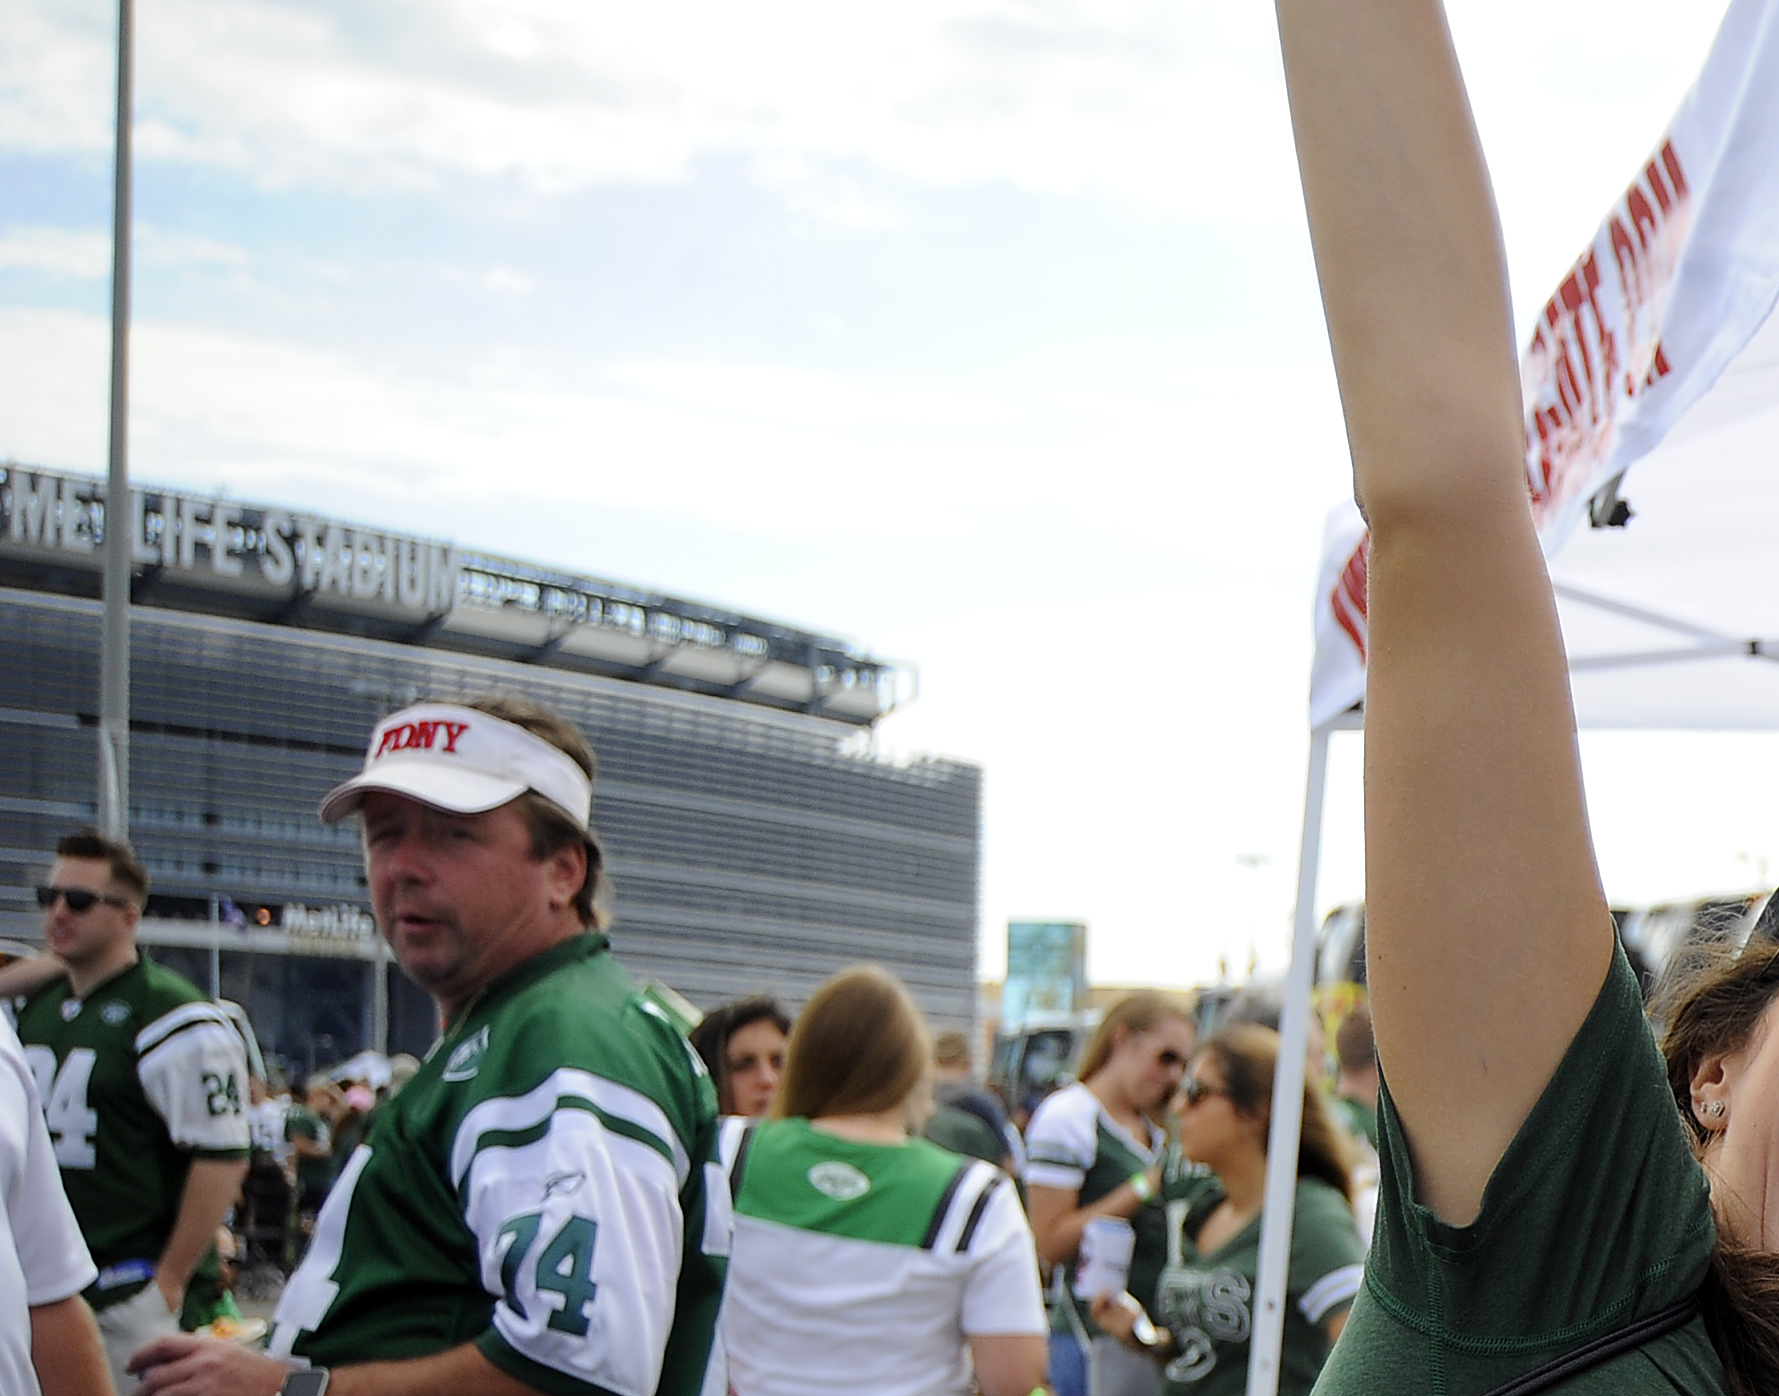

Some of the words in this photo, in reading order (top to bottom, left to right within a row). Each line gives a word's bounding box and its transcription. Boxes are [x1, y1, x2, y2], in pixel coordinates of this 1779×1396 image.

[10, 470, 245, 578] MELIFE
[261, 508, 456, 611] STADIUM
[375, 720, 469, 759] FDNY
[202, 1073, 240, 1115] 24
[499, 1212, 598, 1337] 74
